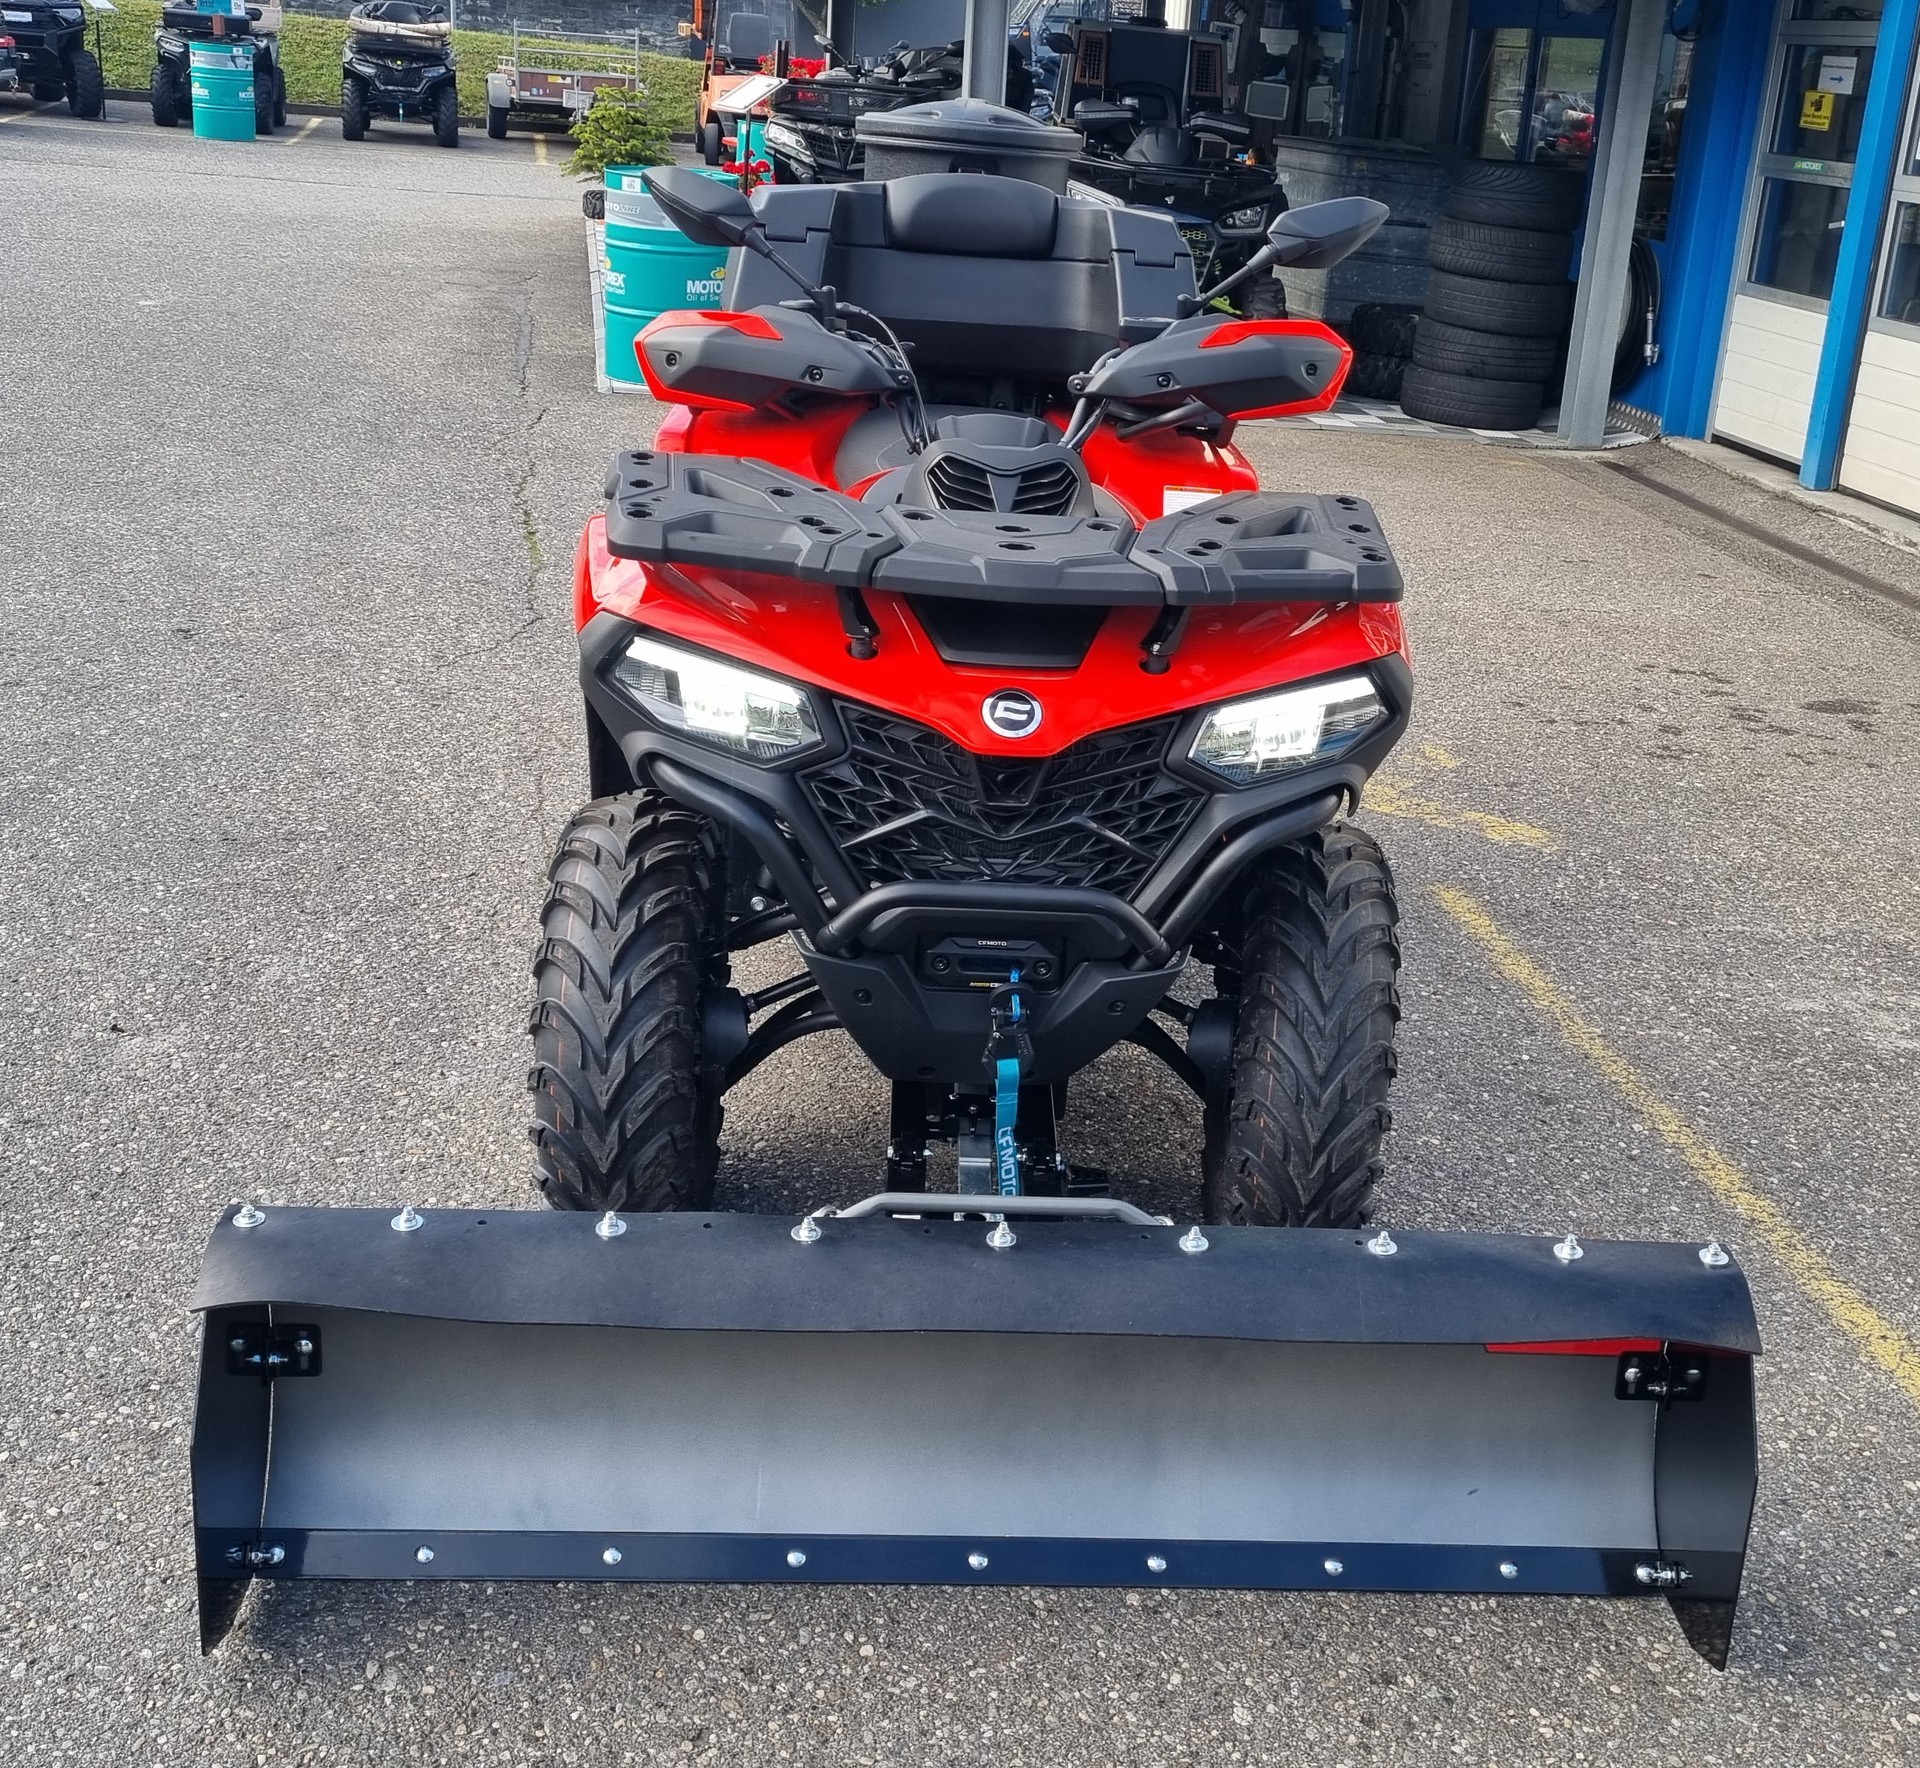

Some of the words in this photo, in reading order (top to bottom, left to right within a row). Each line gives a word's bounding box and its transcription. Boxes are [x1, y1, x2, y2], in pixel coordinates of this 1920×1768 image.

[686, 279, 724, 294] MOTO
[686, 294, 698, 302] Oil
[700, 294, 708, 302] of
